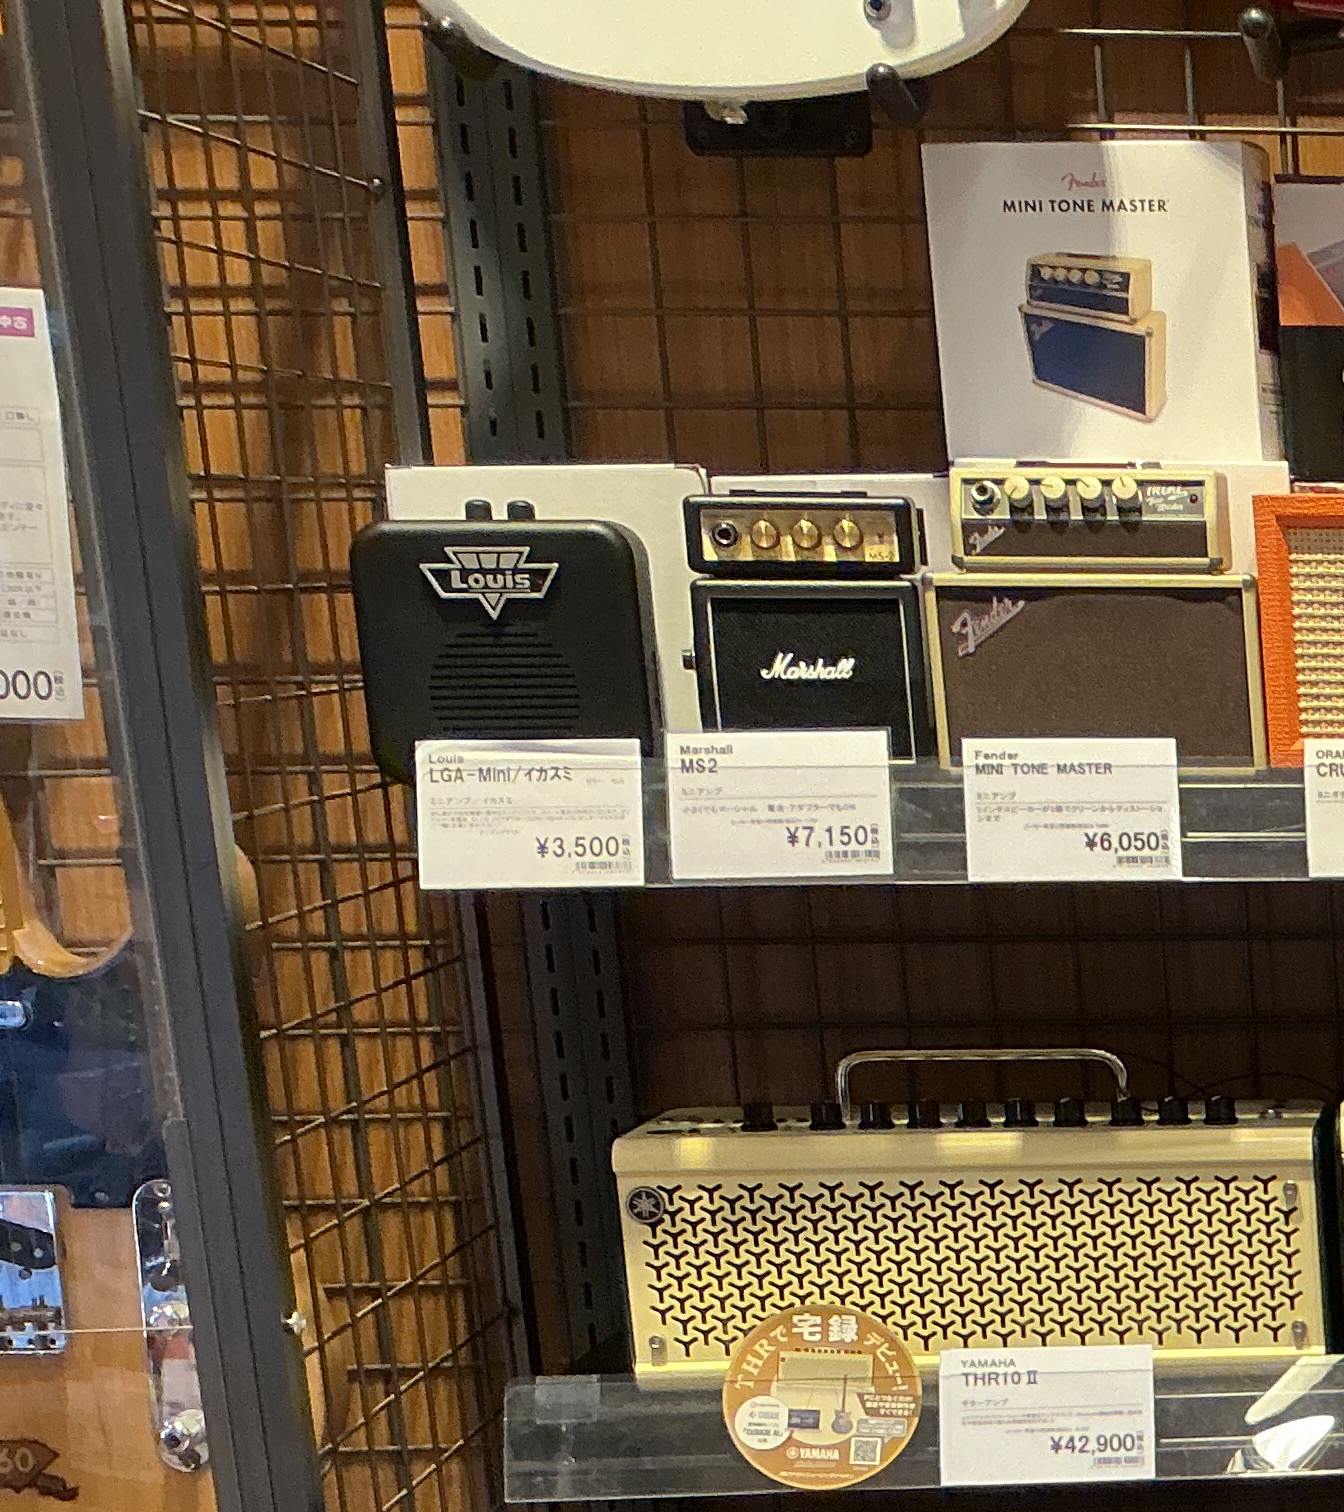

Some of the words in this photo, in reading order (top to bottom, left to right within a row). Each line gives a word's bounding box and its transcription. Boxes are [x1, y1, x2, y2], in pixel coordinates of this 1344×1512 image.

[1003, 199, 1043, 213] MINI
[1048, 199, 1096, 213] TONE
[1102, 199, 1168, 213] MASTER
[449, 570, 532, 592] Louis
[952, 596, 1026, 659] Fender
[760, 654, 855, 681] Marshall
[680, 745, 733, 755] Marshall
[975, 751, 1019, 760] Fender
[428, 754, 463, 764] Louis
[680, 759, 718, 774] MS2
[976, 763, 1003, 775] MINI
[1012, 763, 1048, 775] TONE
[1056, 763, 1113, 775] MASTER
[786, 825, 867, 848] ¥7,150
[1084, 832, 1159, 853] ¥6,050
[536, 836, 619, 858] ¥3,500
[792, 1313, 858, 1342] 宅録
[961, 1358, 1016, 1368] YAMAHA
[1049, 1435, 1135, 1455] ¥42,900
[800, 1448, 839, 1460] YAMAHA
